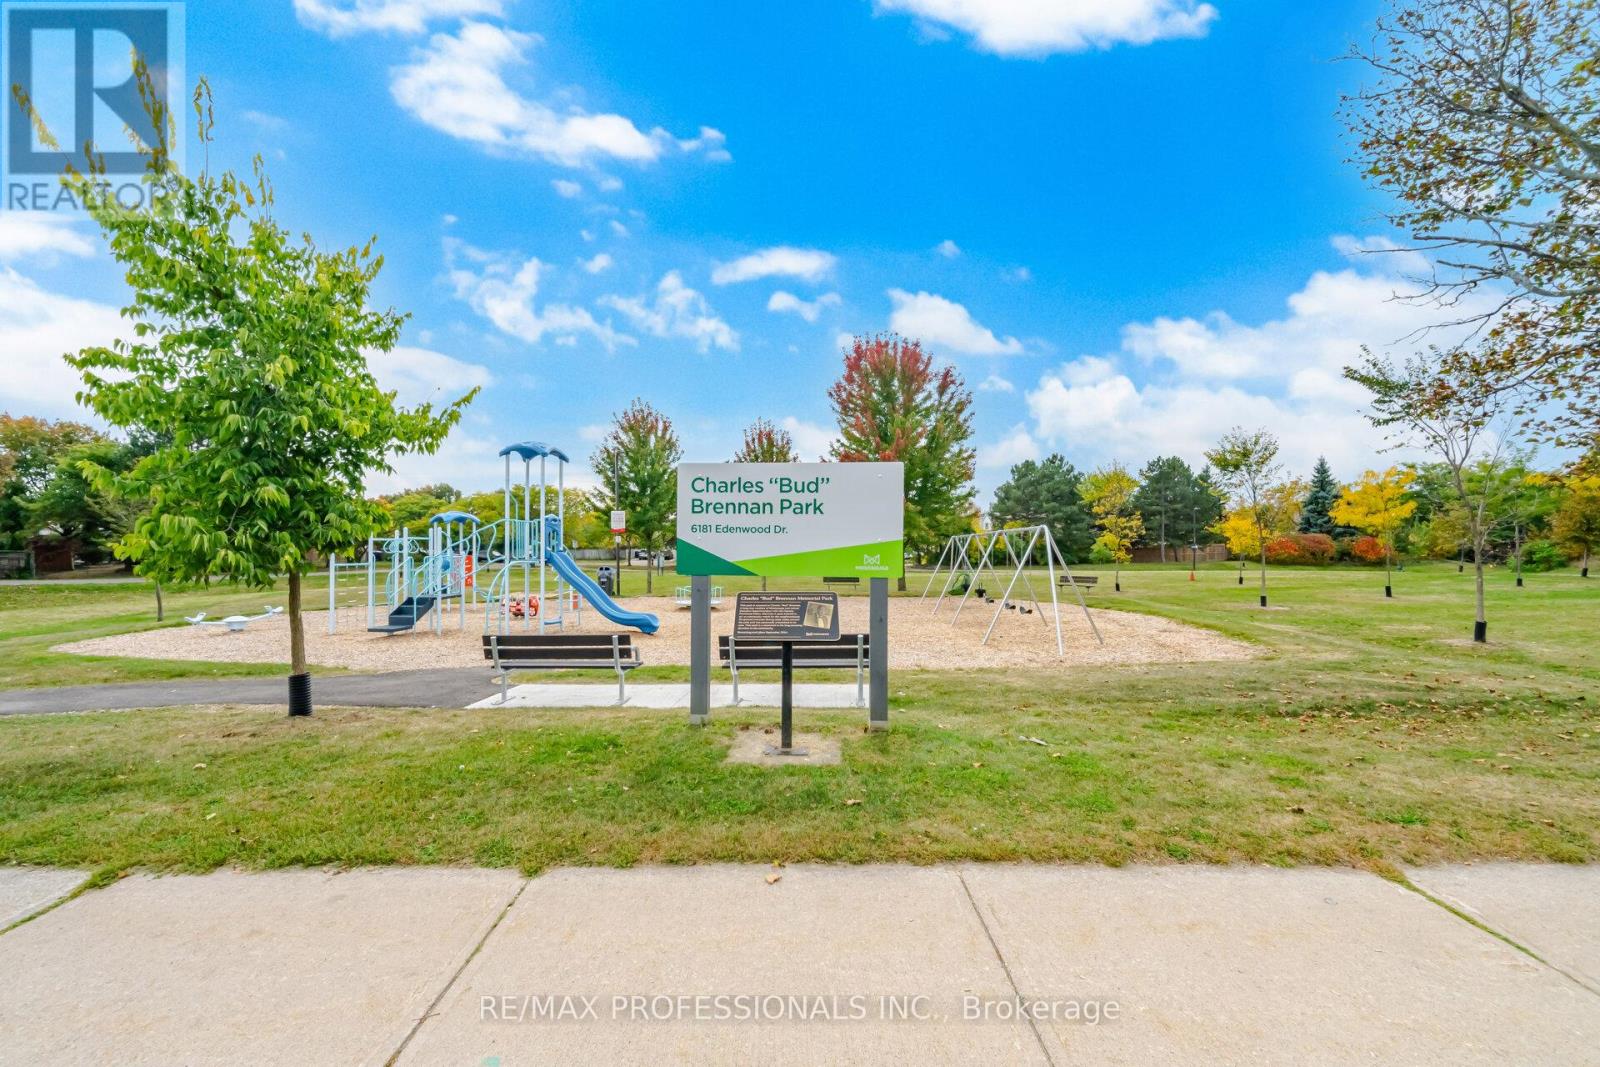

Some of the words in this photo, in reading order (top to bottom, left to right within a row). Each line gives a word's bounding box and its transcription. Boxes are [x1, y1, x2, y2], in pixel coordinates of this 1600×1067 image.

[691, 477, 764, 494] Charles
[691, 499, 773, 515] Brennan
[780, 499, 824, 515] Park
[691, 525, 712, 534] 6181
[715, 525, 771, 534] Edenwood
[774, 525, 788, 534] Dr.
